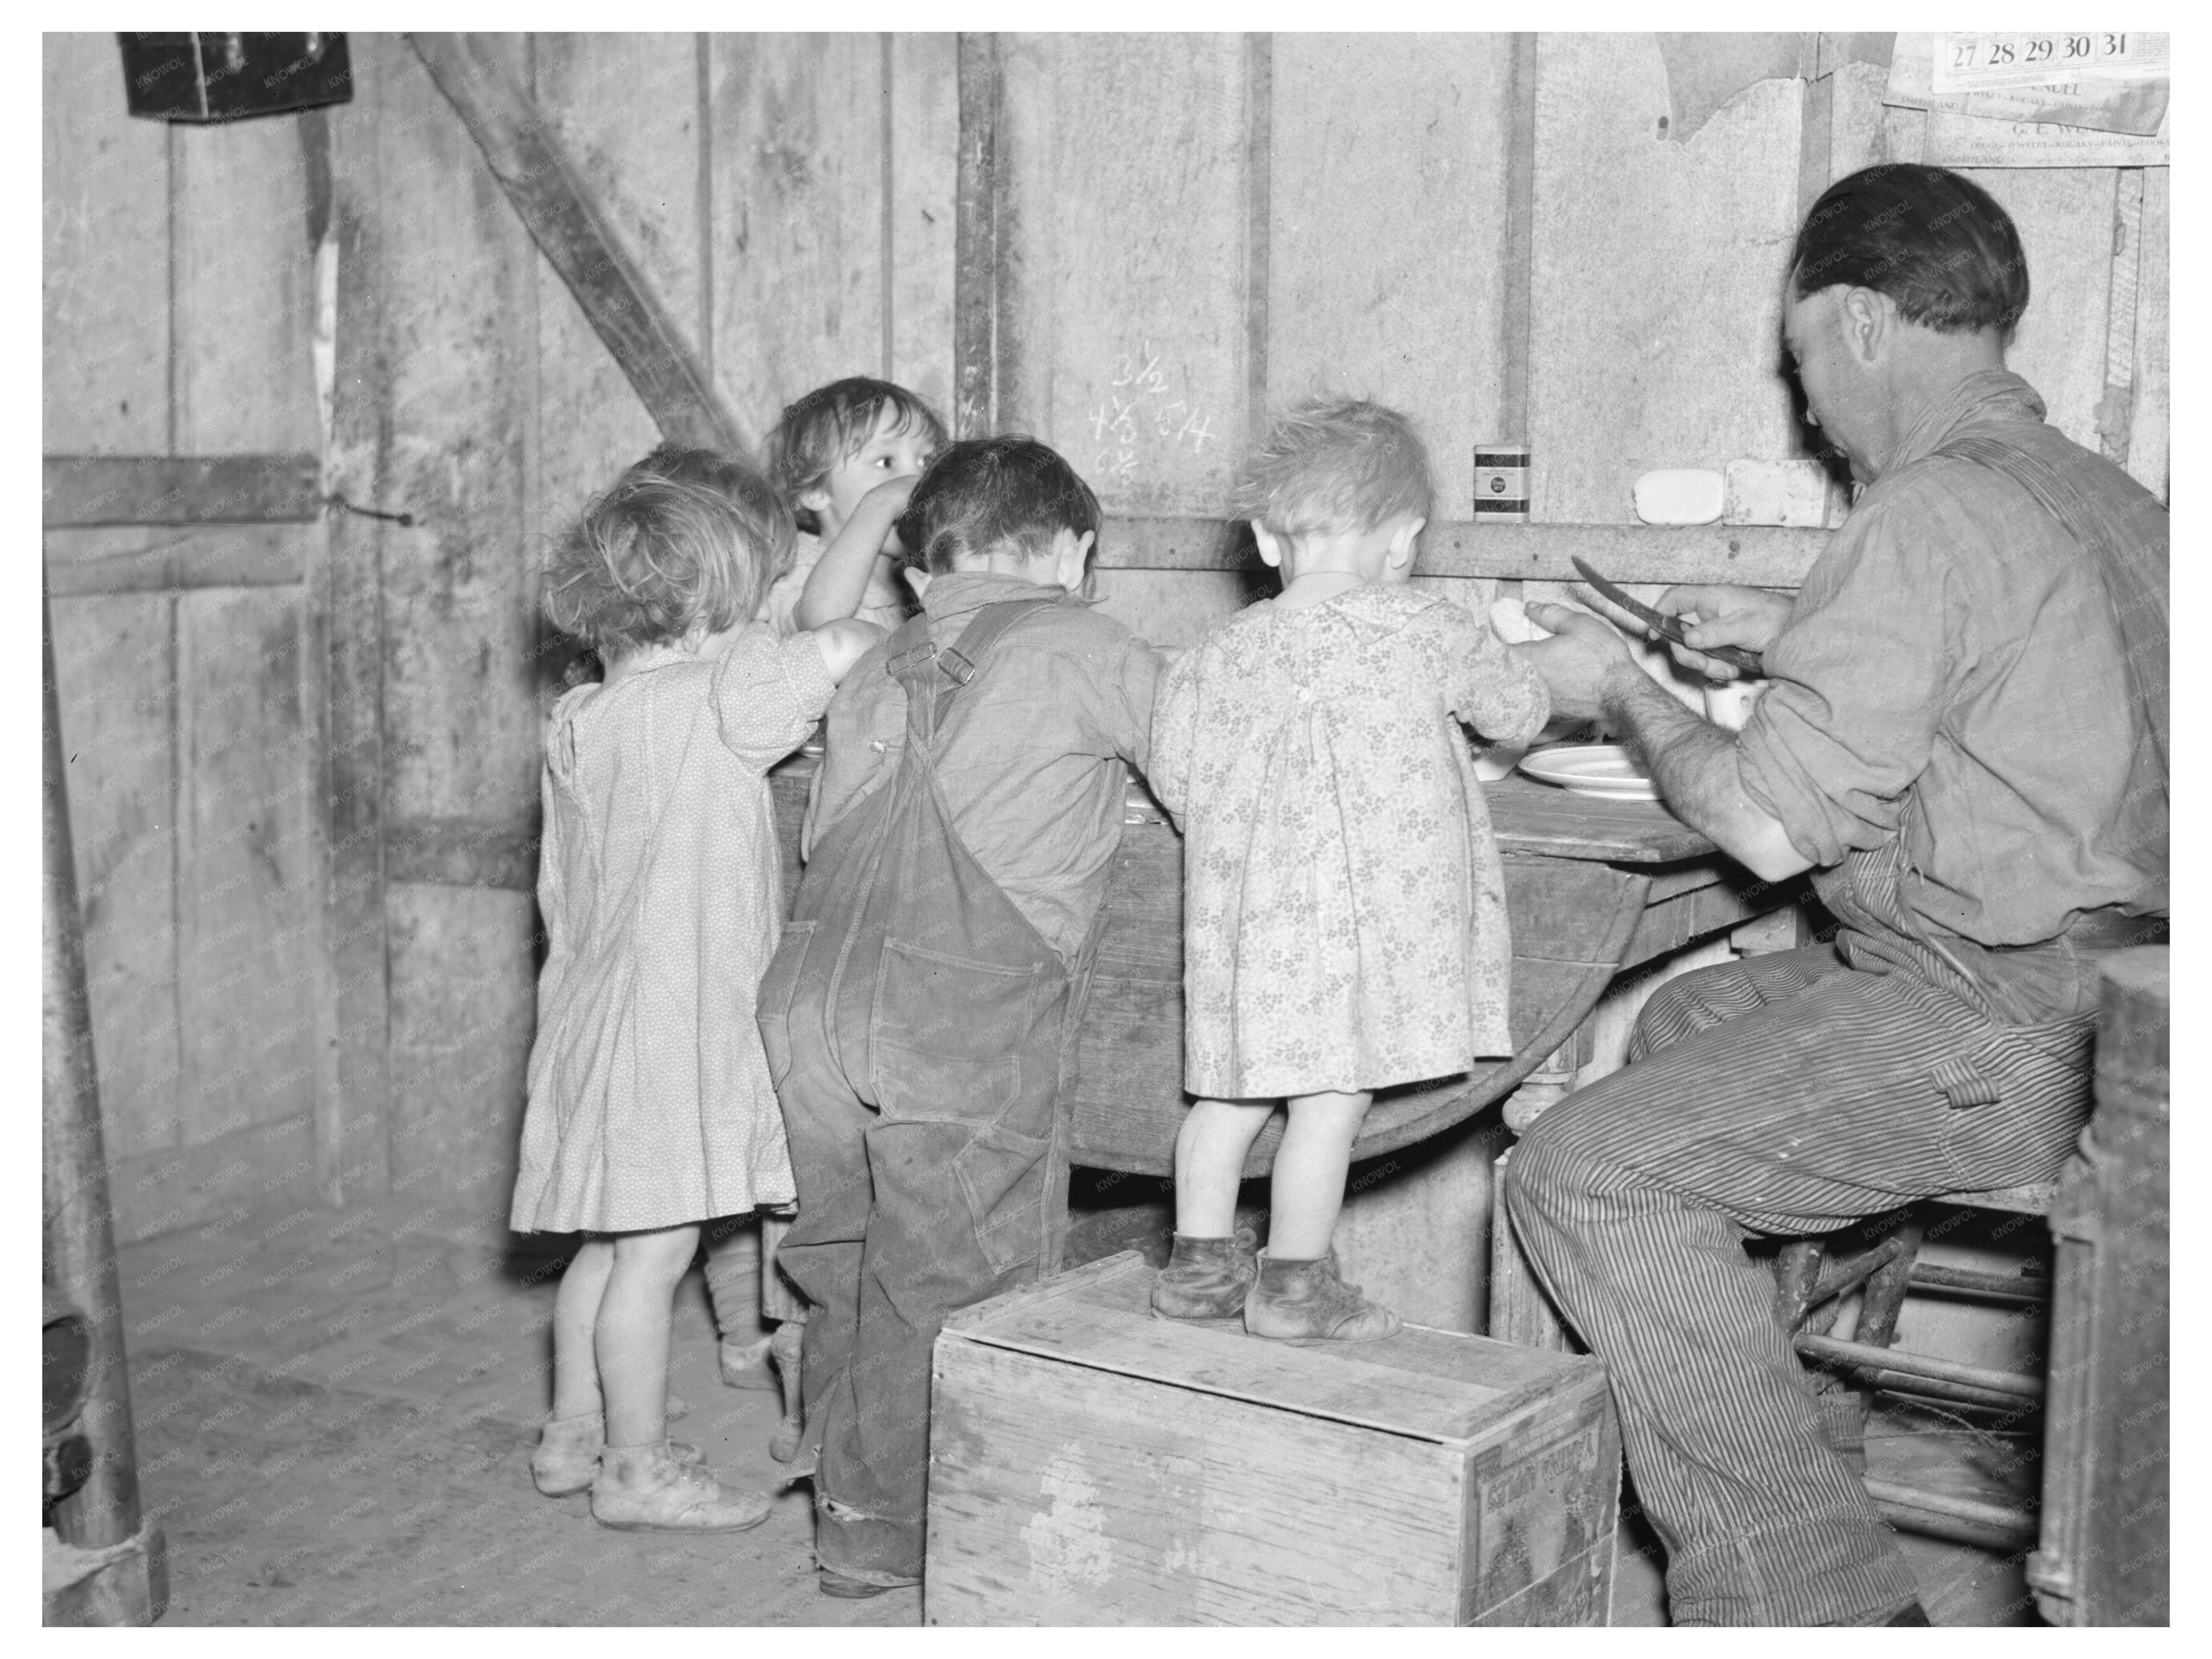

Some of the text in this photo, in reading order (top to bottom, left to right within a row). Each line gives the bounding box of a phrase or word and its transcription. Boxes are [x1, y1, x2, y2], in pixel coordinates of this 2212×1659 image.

[1952, 45, 1977, 67] 27
[1988, 43, 2015, 65] 28
[2025, 40, 2053, 61] 29
[2062, 36, 2091, 58] 30
[2103, 33, 2126, 55] 31
